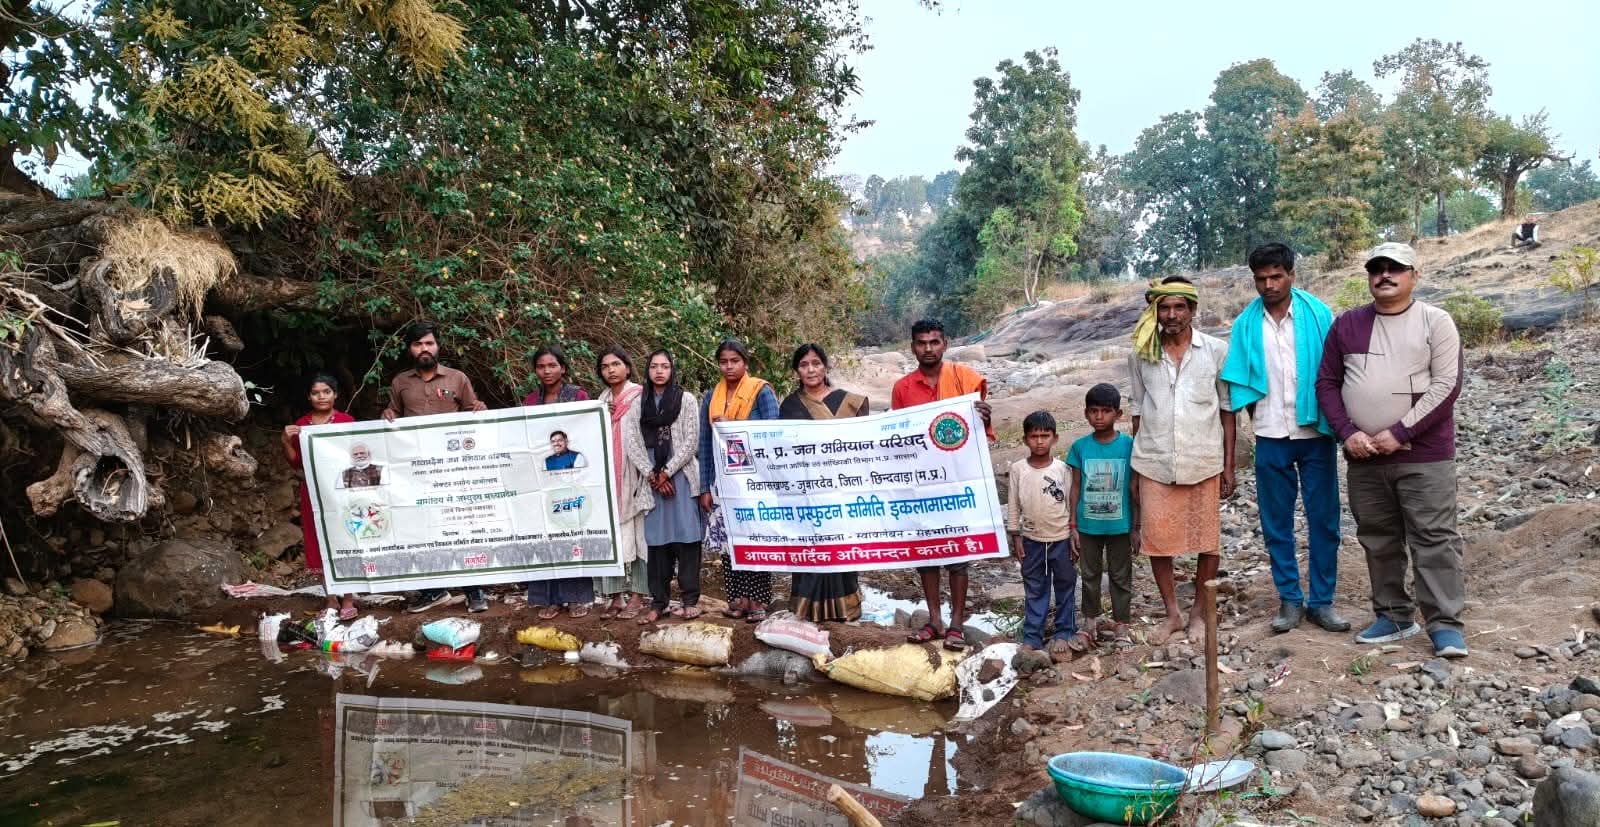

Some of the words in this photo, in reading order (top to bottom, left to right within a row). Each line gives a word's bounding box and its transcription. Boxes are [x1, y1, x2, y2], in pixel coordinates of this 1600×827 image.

[792, 444, 815, 455] जन
[821, 438, 875, 455] अभियान
[879, 434, 928, 450] परिषद्
[747, 479, 789, 491] विकासखण्ड
[839, 474, 863, 487] जिला
[871, 471, 912, 485] छिन्दवाड़ा
[553, 504, 560, 512] 2
[734, 508, 755, 523] ग्राम
[758, 501, 794, 521] विकास
[796, 504, 842, 527] प्रस्फुटन
[846, 496, 885, 518] समिति
[889, 486, 976, 520] इकलामासानी
[916, 525, 968, 537] सहभागिता
[745, 551, 786, 561] आपका
[788, 548, 831, 563] हार्दिक
[837, 546, 910, 562] अभिनन्दन
[915, 543, 959, 557] करती
